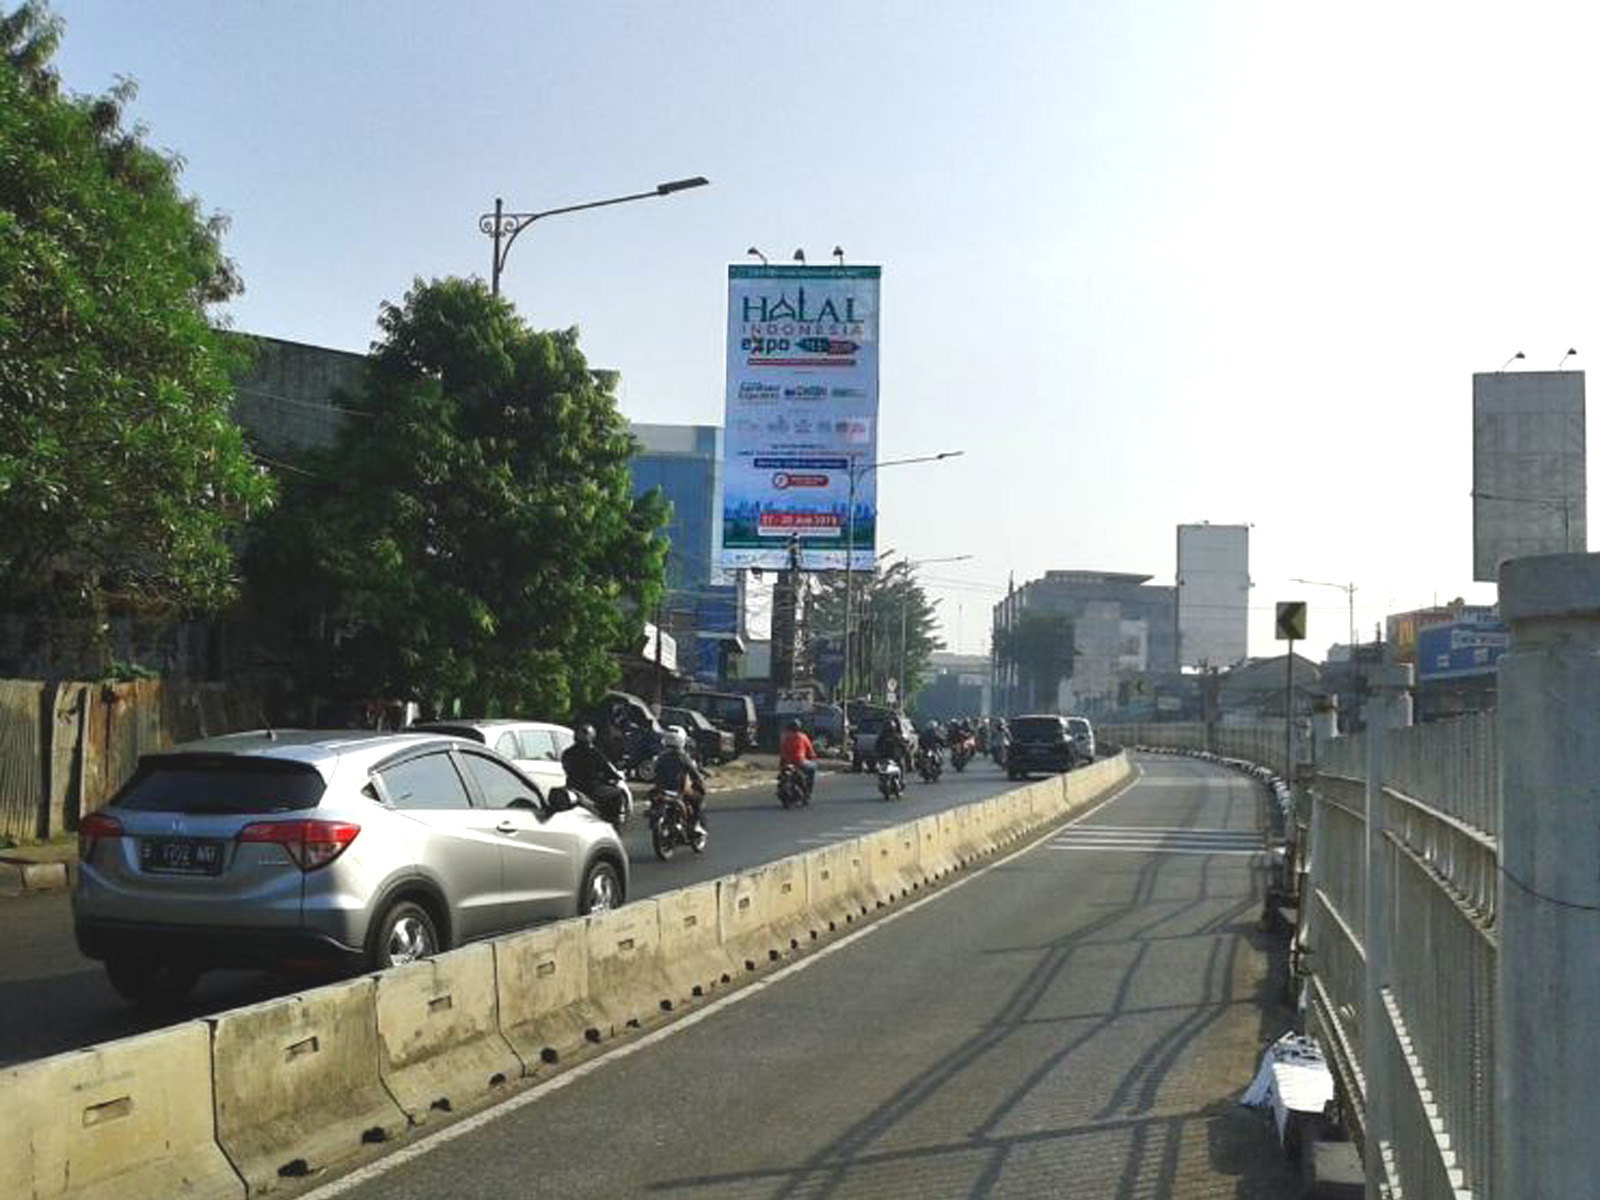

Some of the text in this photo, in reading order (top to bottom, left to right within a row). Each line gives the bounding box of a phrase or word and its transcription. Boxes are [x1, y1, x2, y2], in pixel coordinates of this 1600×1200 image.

[742, 286, 864, 323] HALAL
[742, 323, 863, 336] INDONESIA
[741, 337, 790, 355] expo
